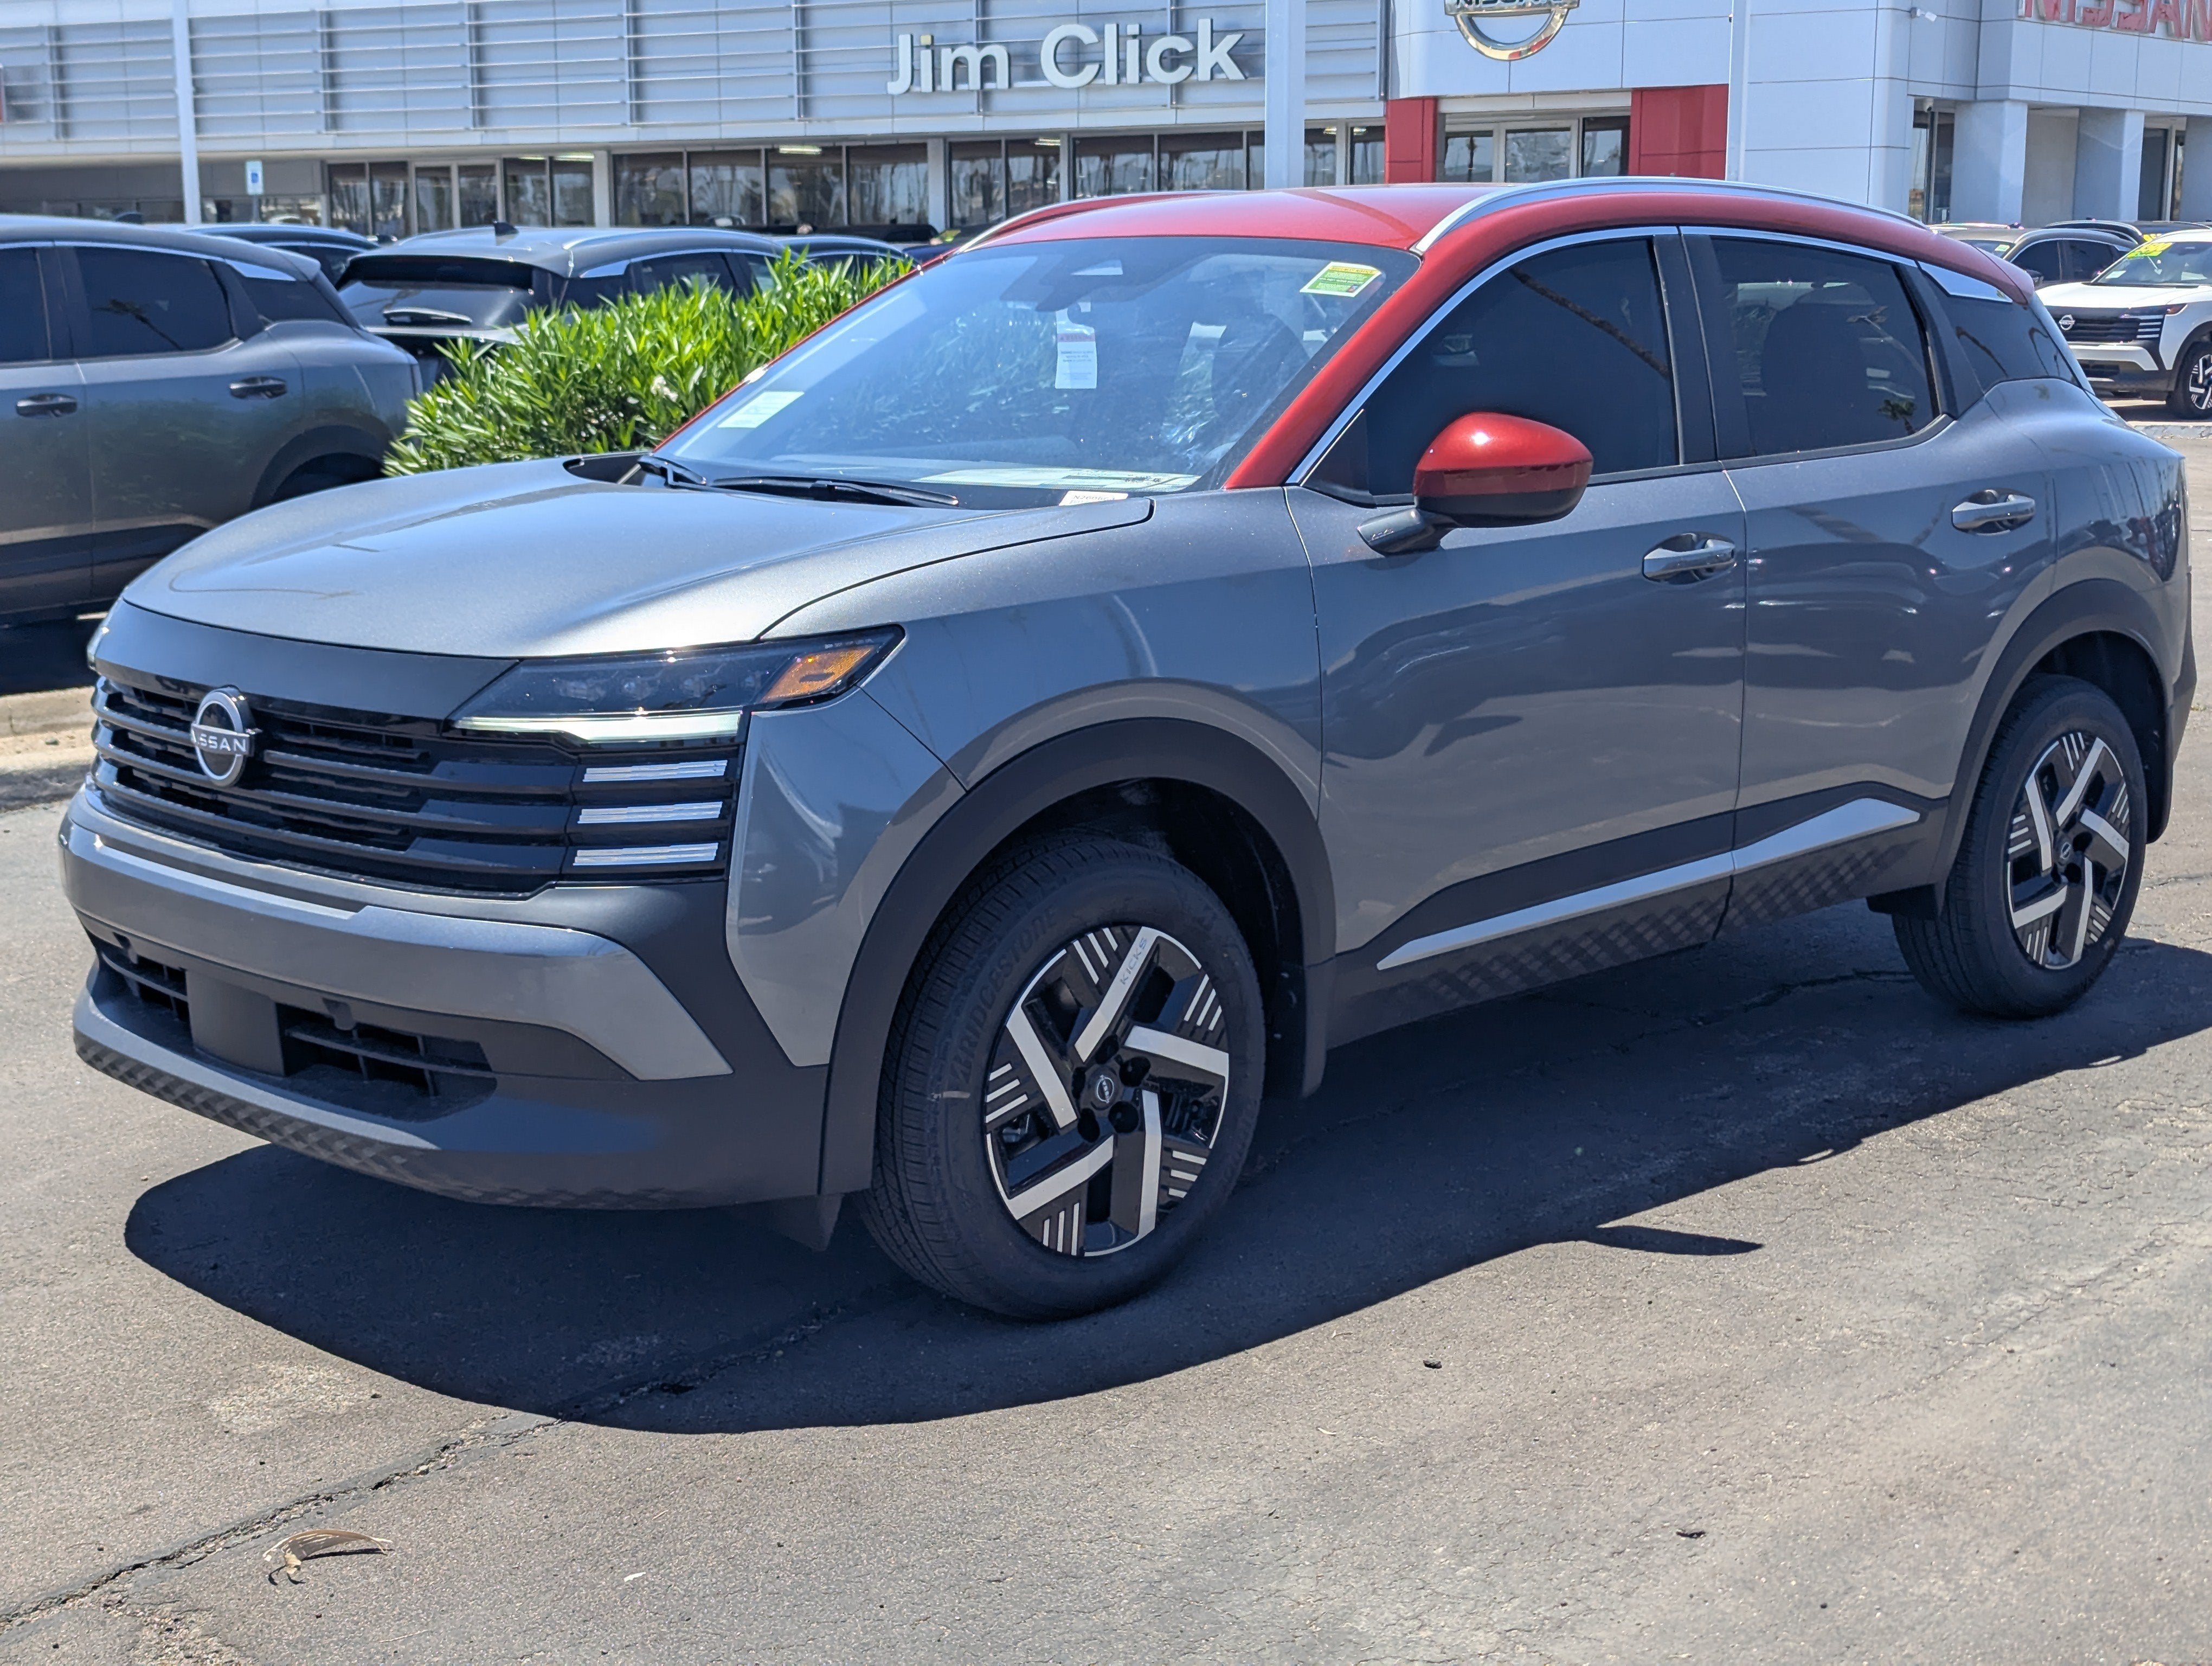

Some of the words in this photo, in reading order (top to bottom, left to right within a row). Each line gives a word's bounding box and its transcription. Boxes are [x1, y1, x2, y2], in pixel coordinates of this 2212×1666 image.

[887, 33, 1011, 95] Jim
[1040, 18, 1248, 89] Click
[1120, 937, 1147, 985] KICKS
